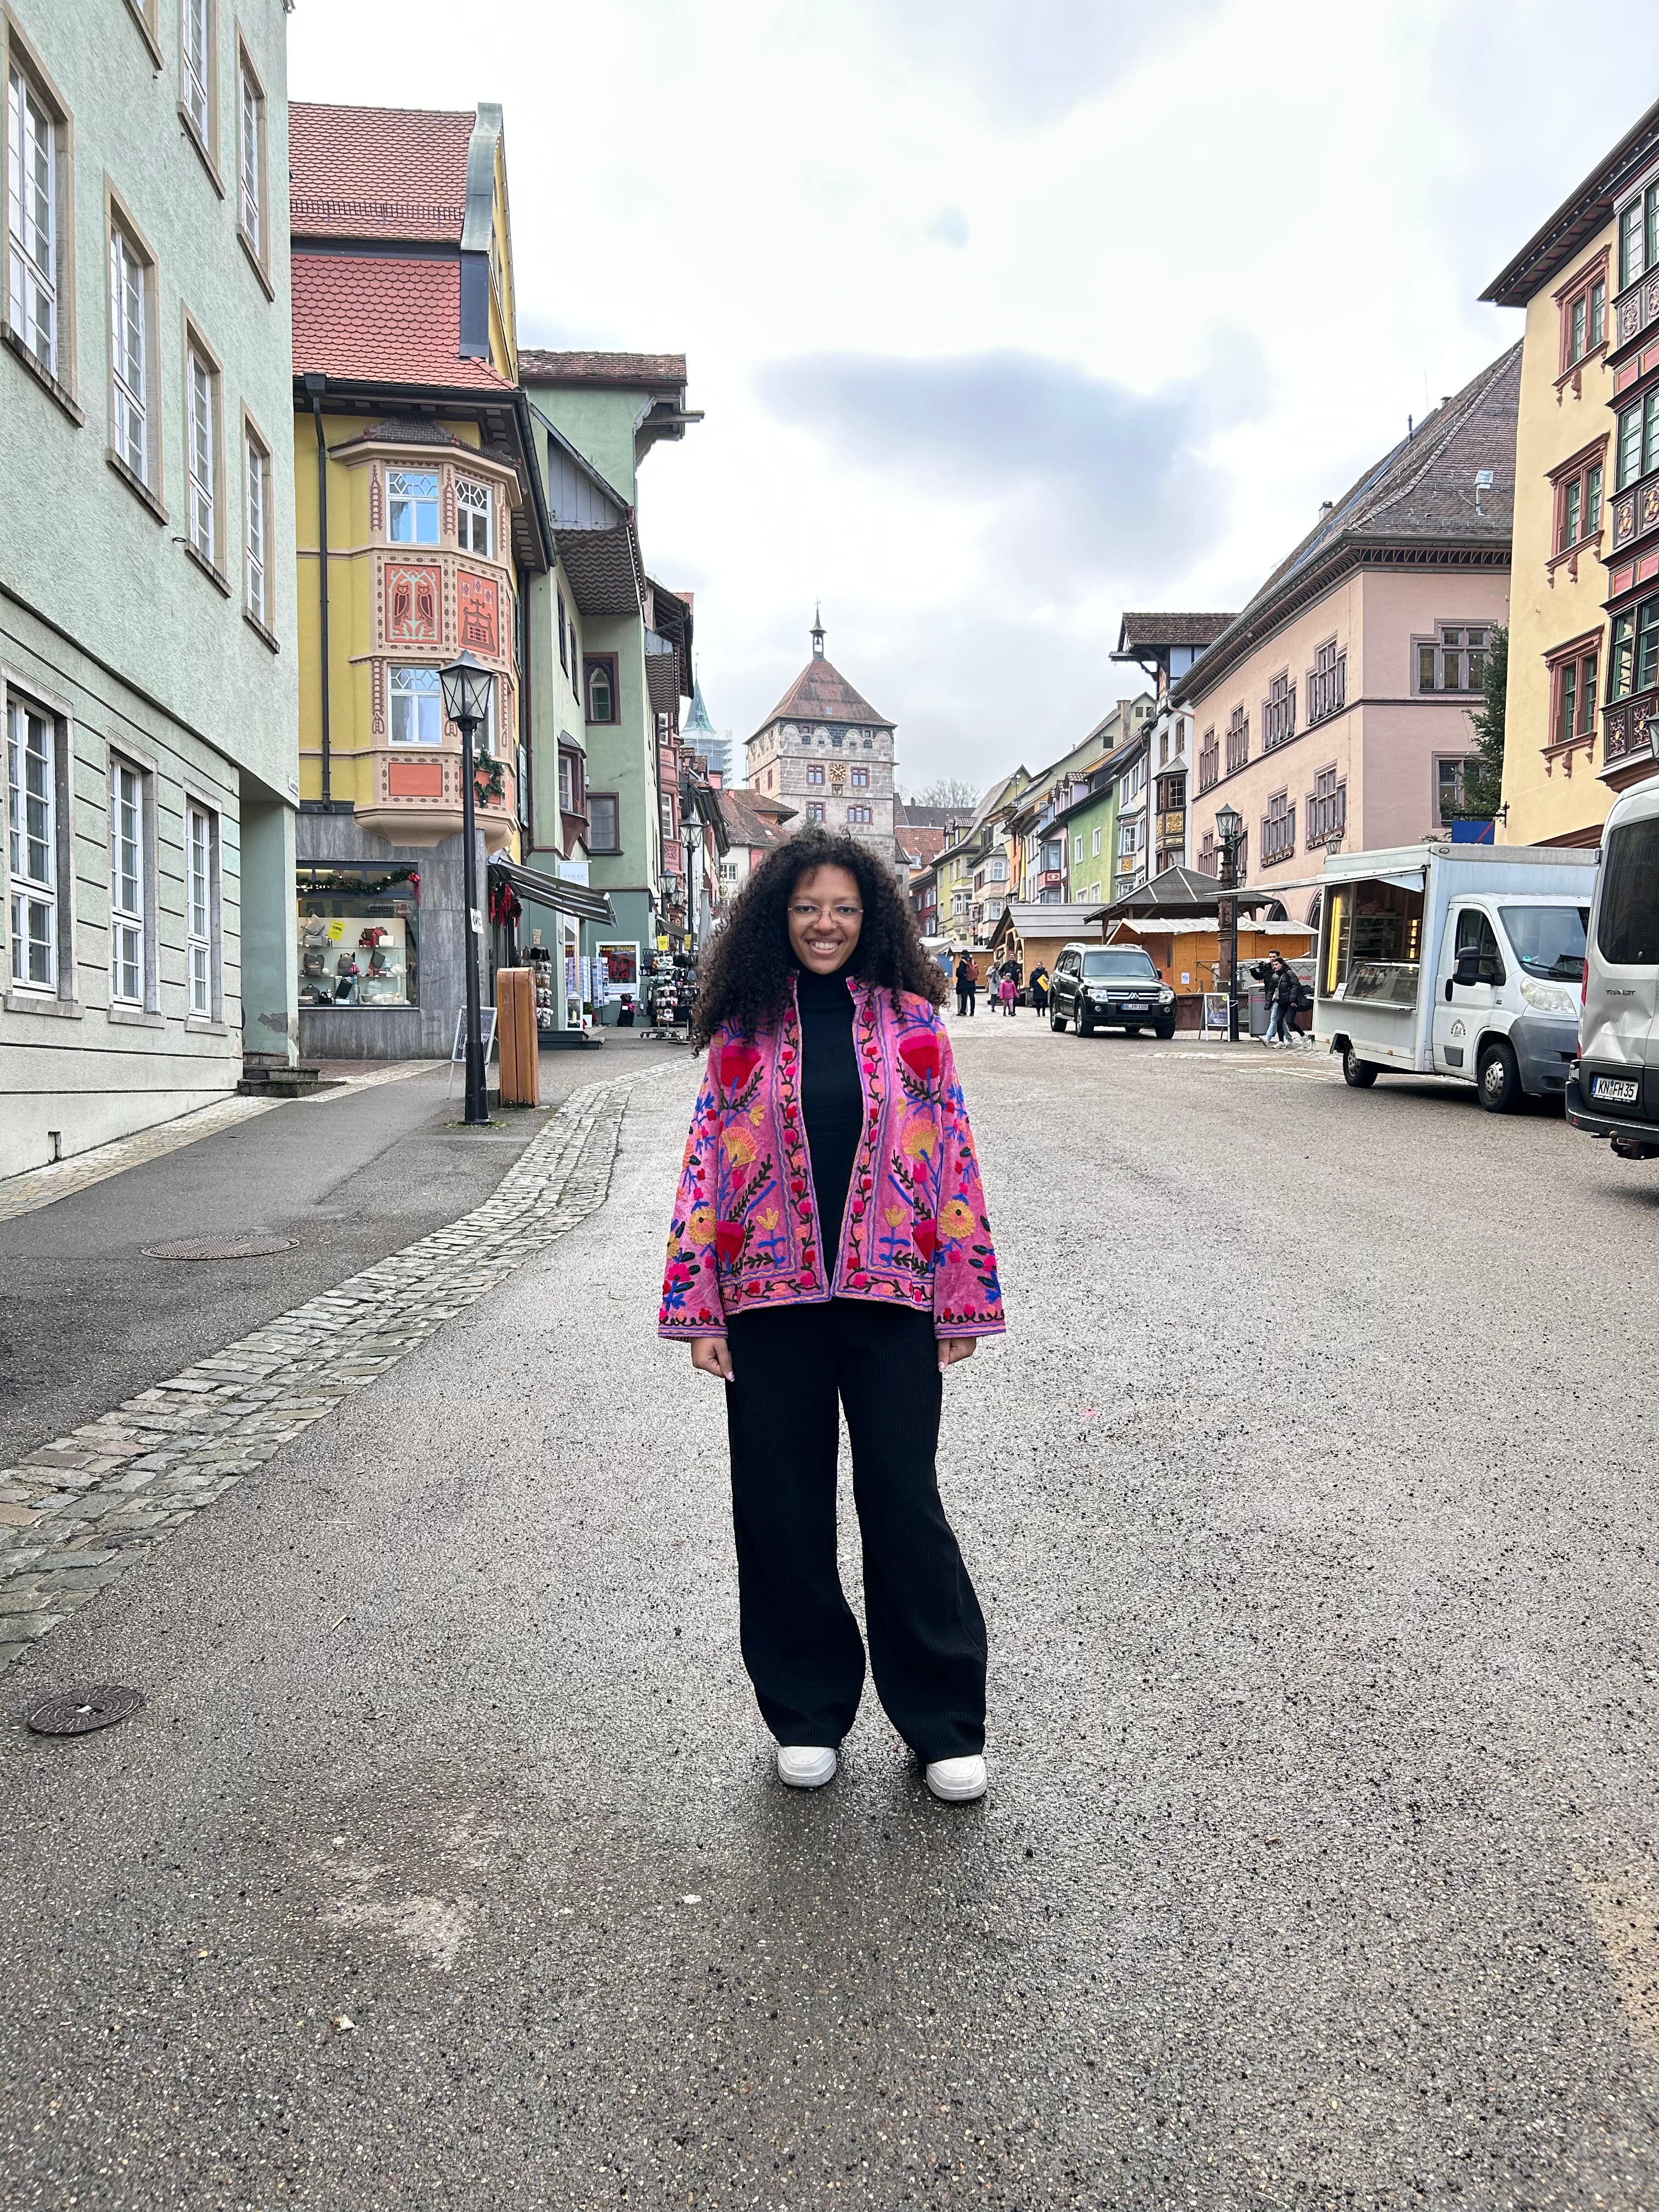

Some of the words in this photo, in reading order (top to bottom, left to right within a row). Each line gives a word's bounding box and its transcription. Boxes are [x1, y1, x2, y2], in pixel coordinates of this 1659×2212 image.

[1598, 1080, 1611, 1094] KN
[1613, 1081, 1624, 1097] FH
[1624, 1083, 1635, 1098] 35
